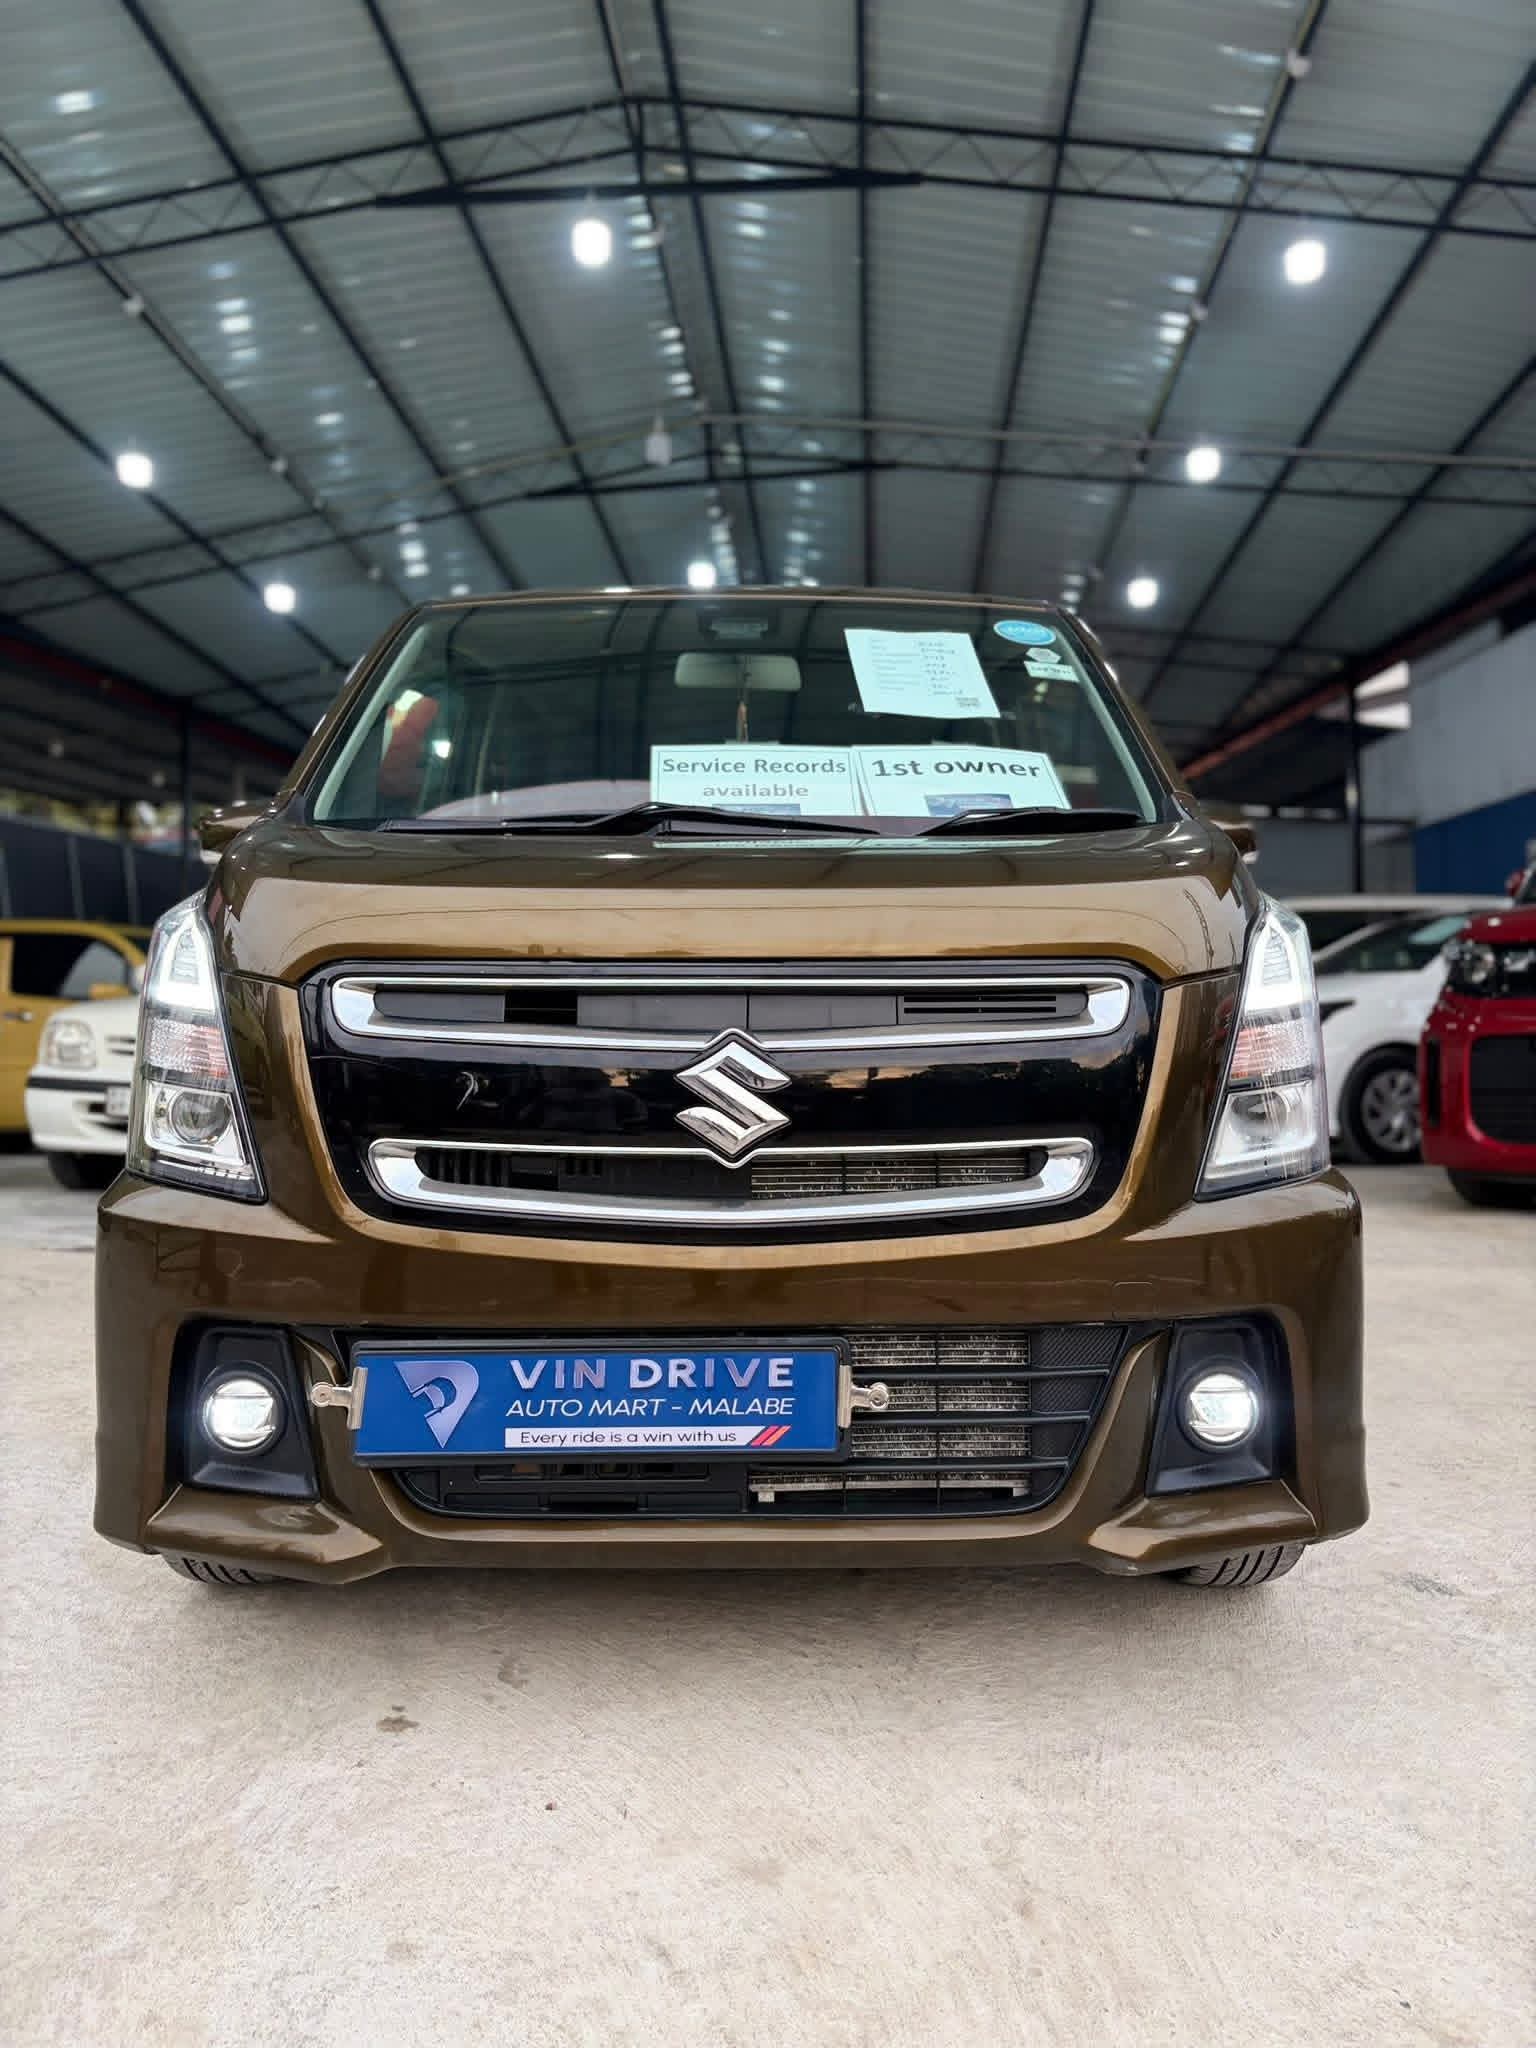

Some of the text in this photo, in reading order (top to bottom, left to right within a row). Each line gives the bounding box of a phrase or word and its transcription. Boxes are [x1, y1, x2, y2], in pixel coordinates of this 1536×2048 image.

[663, 758, 846, 773] Service Records
[872, 759, 1040, 777] 1st owner
[703, 784, 809, 797] available
[510, 1357, 794, 1389] VIN DRIVE
[505, 1399, 583, 1417] AUTO
[588, 1398, 667, 1417] MART
[688, 1398, 796, 1416] MALABE
[520, 1430, 737, 1446] Every ride is a win with us
